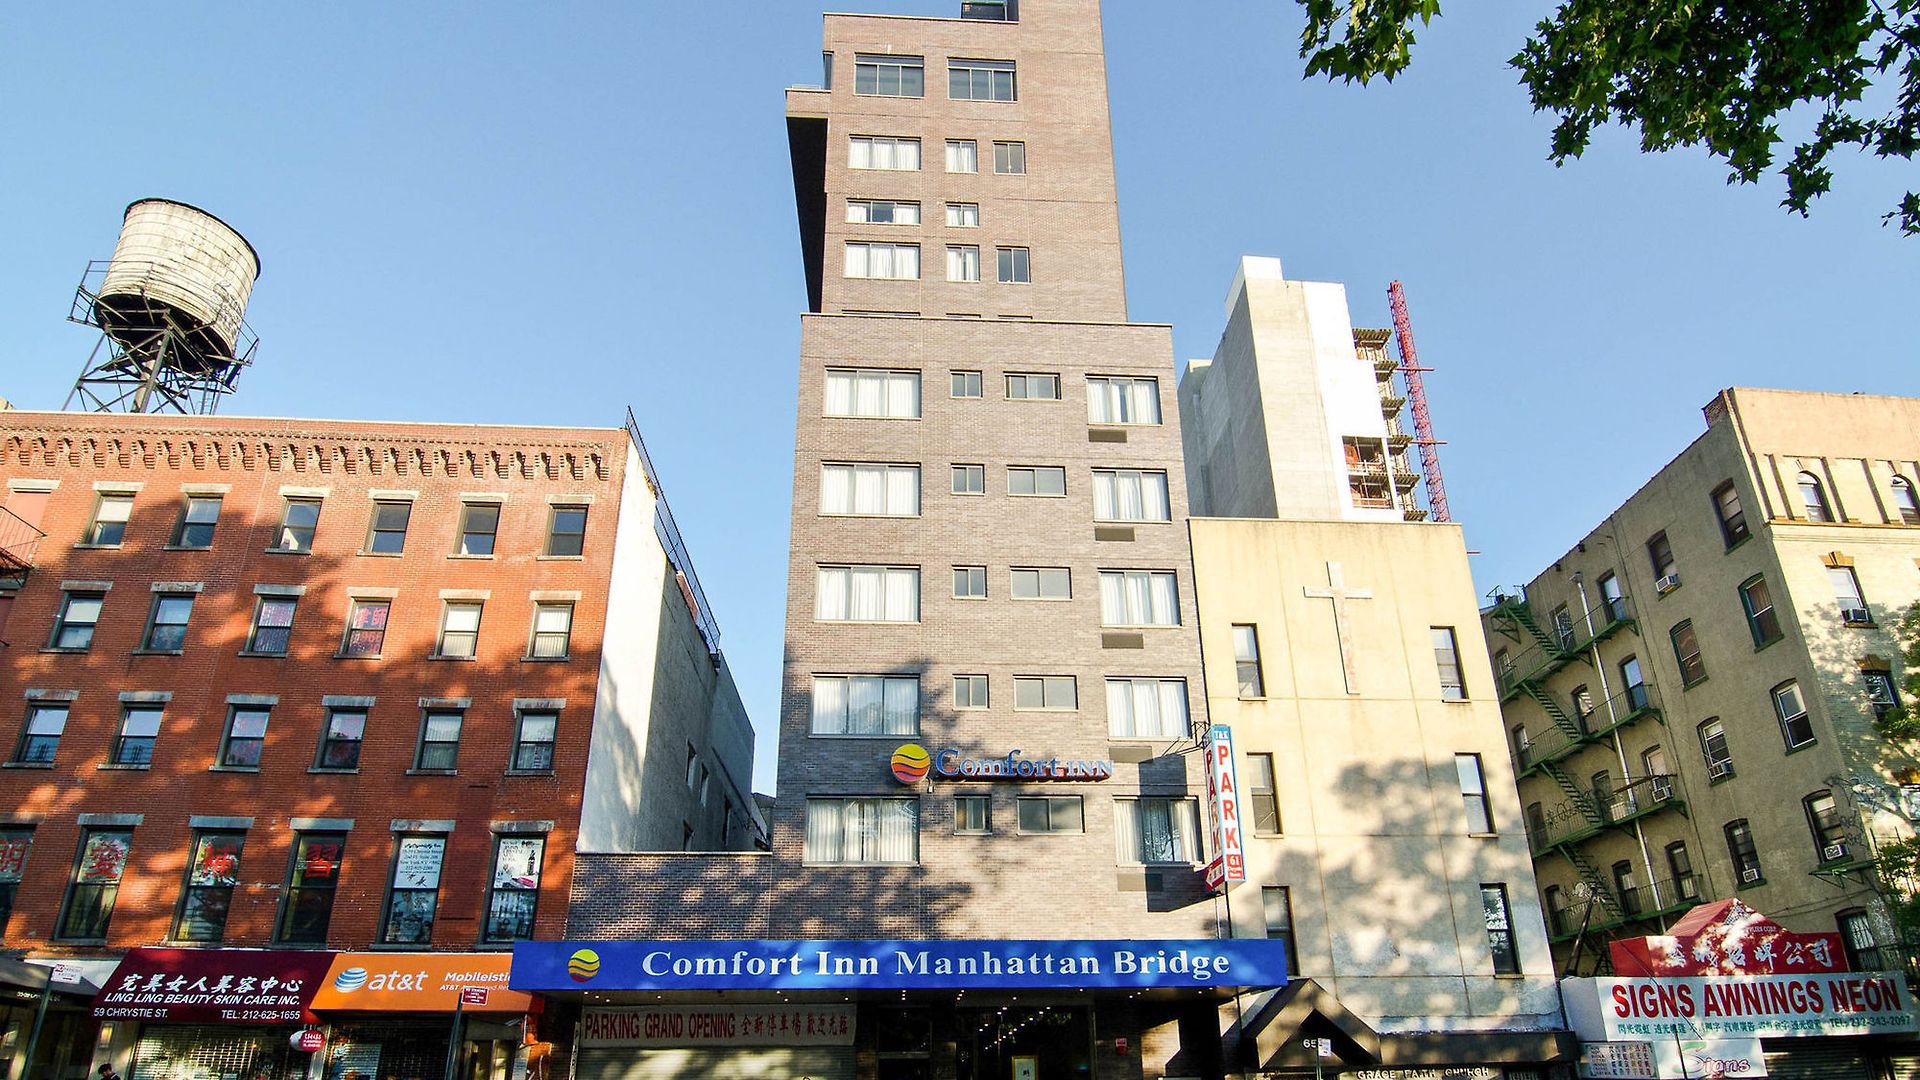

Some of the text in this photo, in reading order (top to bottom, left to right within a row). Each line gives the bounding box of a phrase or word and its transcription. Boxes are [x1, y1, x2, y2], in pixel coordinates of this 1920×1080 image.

[936, 749, 1113, 776] Comfort INN
[1217, 745, 1239, 849] PARK
[1229, 855, 1240, 864] 61
[642, 951, 1230, 980] Comfort Inn Manhattan Bridge
[118, 973, 303, 995] 完美女人美容中心
[368, 970, 429, 991] at&t
[104, 993, 300, 1005] LING LING BEAUTY SKIN CARE INC.
[1612, 979, 1902, 1018] SIGNS AWNINGS NEON
[94, 1008, 168, 1018] 59 CHRYSTIE ST.
[221, 1009, 300, 1020] TEL: 212-625-1655
[584, 1013, 640, 1039] PARKING
[645, 1013, 684, 1039] GRAND
[689, 1013, 736, 1039] OPENING
[1357, 1067, 1489, 1080] GRACE FAITH CHURCH
